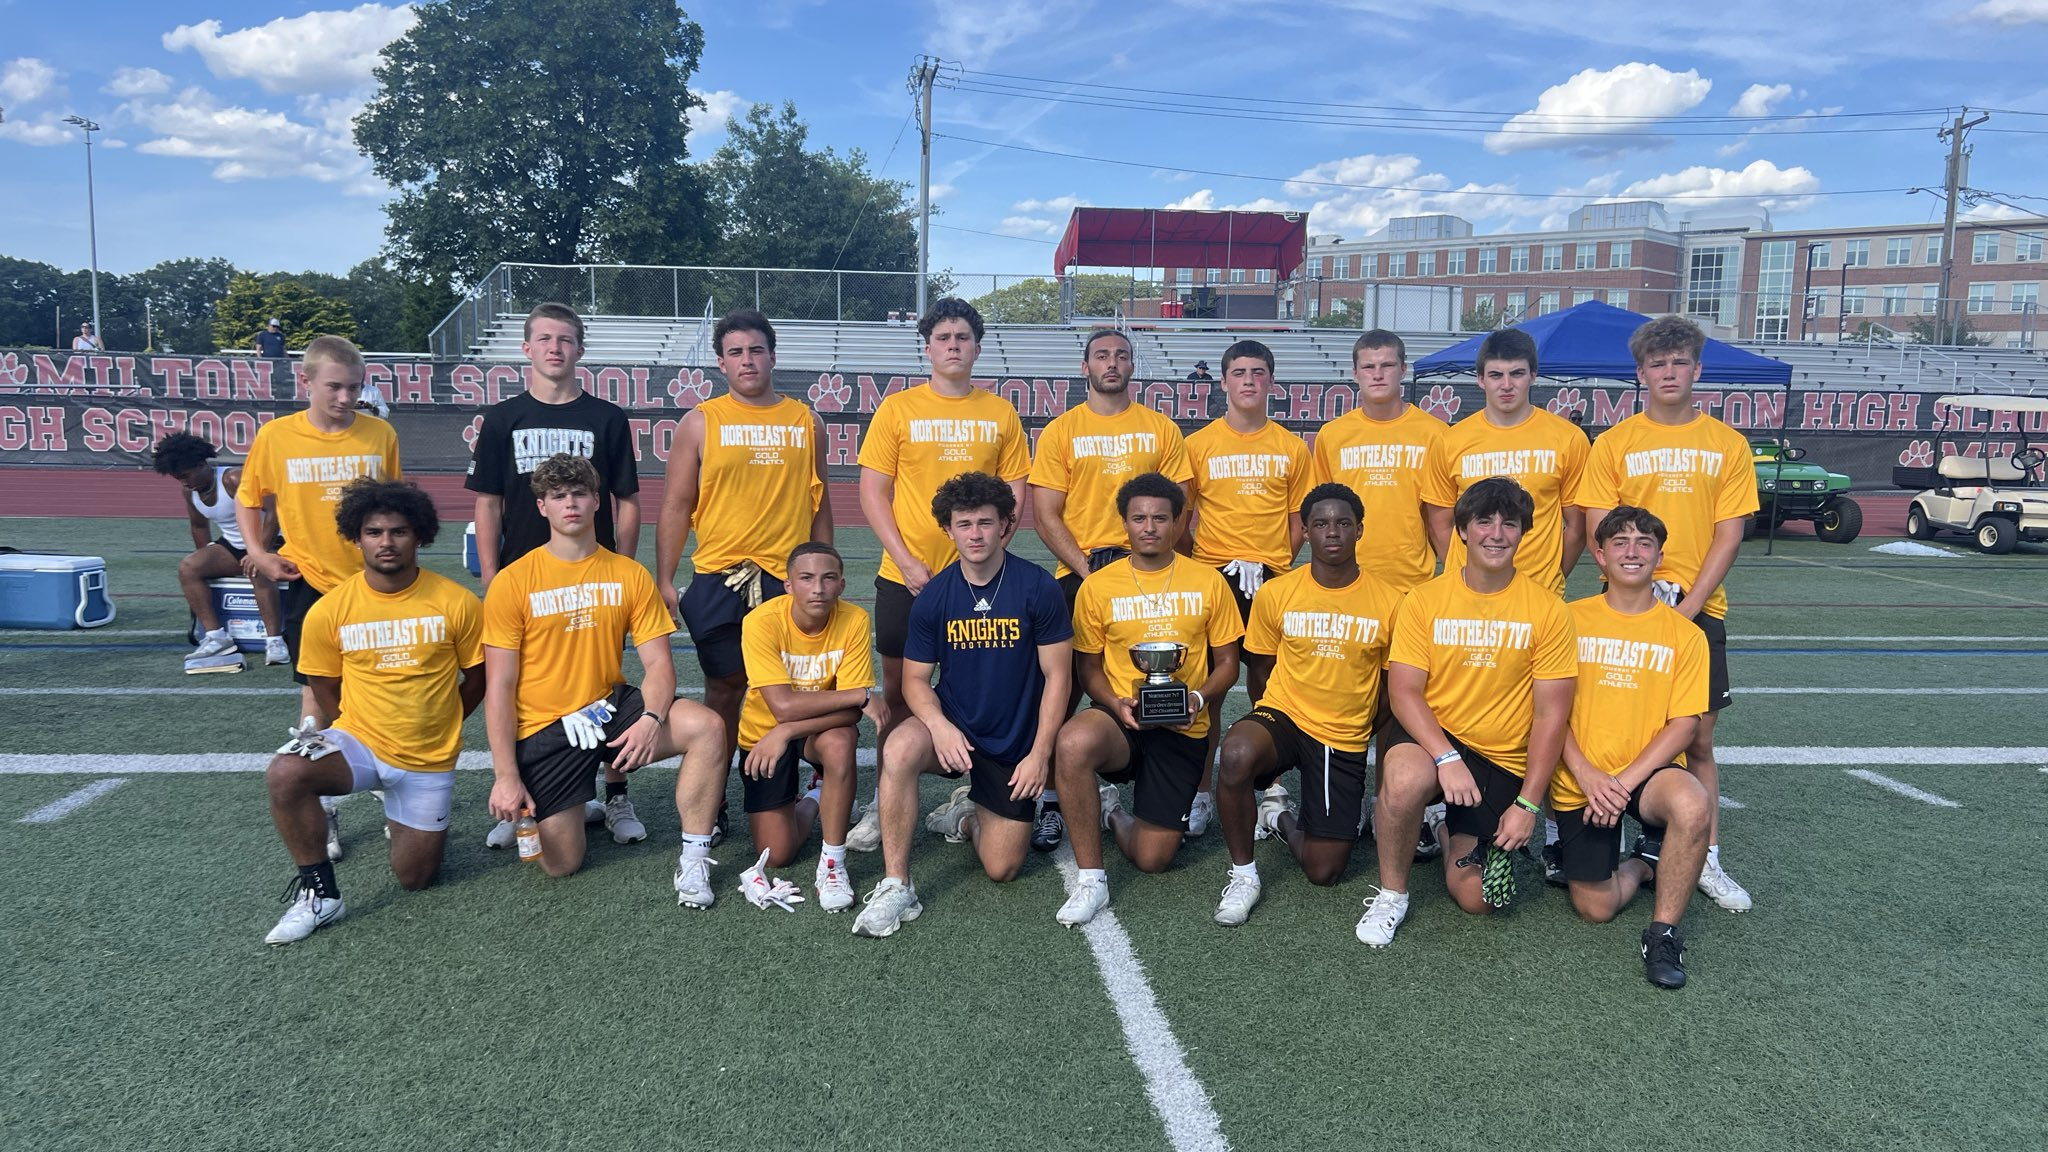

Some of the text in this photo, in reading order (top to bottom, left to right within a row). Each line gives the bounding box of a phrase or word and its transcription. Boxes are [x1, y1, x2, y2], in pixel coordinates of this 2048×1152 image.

[33, 354, 275, 400] MILTON
[291, 361, 434, 404] GH
[1801, 392, 1921, 431] HIGH
[512, 428, 594, 459] KNIGHTS
[720, 424, 787, 447] NORTHEAST
[909, 419, 998, 444] NORTHEAST 7V7
[1073, 433, 1134, 460] NORTHEAST
[1135, 432, 1156, 454] 7V7
[1339, 444, 1403, 472] NORTHEAST
[1404, 444, 1426, 471] 7V7
[286, 455, 361, 484] NORTHEAST
[1208, 454, 1272, 480] NORTHEAST
[1461, 449, 1556, 479] NORTHEAST 7V7
[1625, 447, 1723, 478] NORTHEAST 7V7
[1369, 473, 1392, 481] GOLD
[528, 582, 623, 619] NORTHEAST 7V7
[1111, 591, 1203, 623] NORTHEAST 7V7
[339, 615, 446, 652] NORTHEAST 7V7
[946, 618, 1021, 643] KNIGHTS
[1148, 623, 1172, 632] GOLD
[1283, 611, 1380, 645] NORTHEAST 7V7
[1433, 618, 1532, 650] NORTHEAST 7V7
[382, 652, 411, 662] GOLD
[952, 640, 1015, 650] FOOTBALL
[1317, 643, 1340, 653] GOLD
[1470, 653, 1492, 661] GOLD
[1648, 643, 1674, 675] 7V7
[1606, 672, 1633, 682] GOLD
